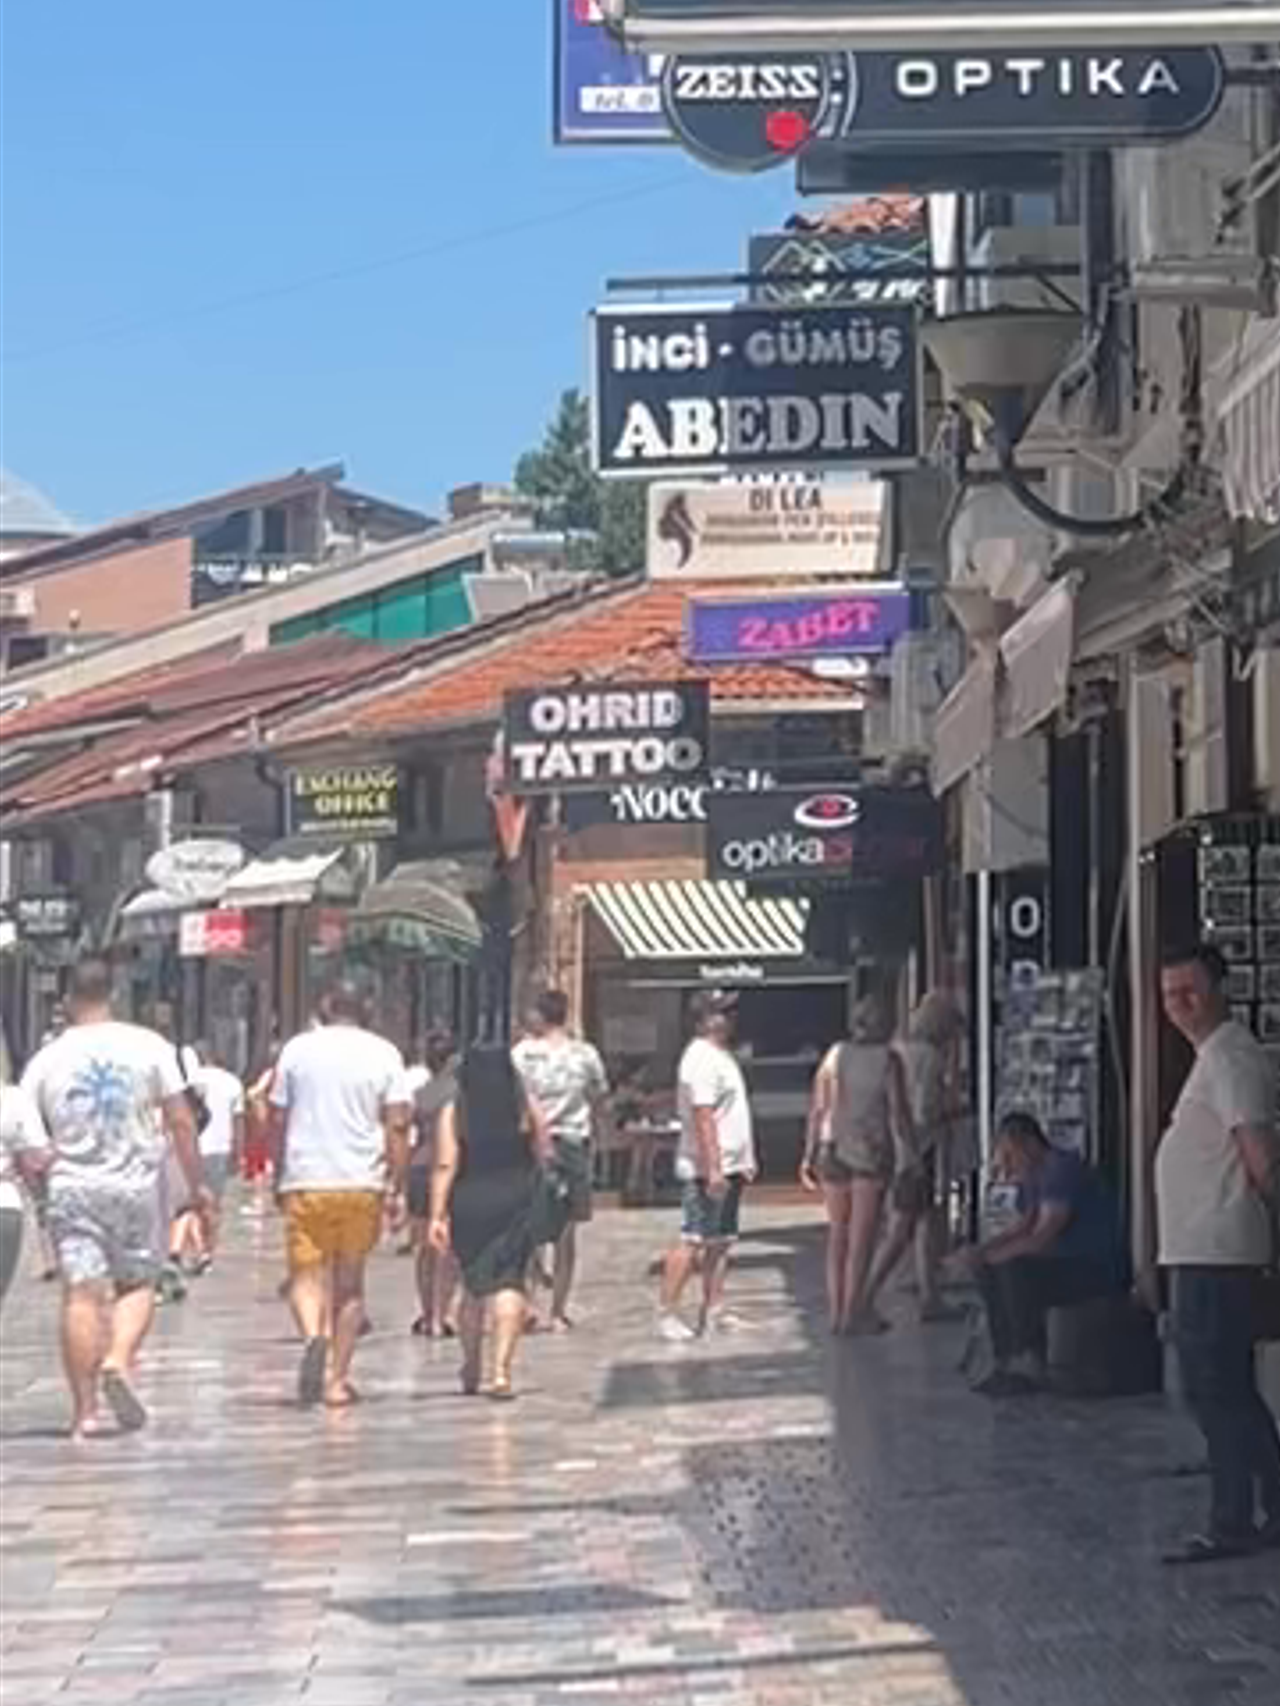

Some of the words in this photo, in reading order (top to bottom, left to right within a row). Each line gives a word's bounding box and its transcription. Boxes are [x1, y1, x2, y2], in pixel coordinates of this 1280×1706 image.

[675, 64, 821, 101] ZEISS
[895, 59, 1182, 98] OPTIKA
[744, 319, 902, 370] GÜMÜŞ
[613, 392, 903, 458] ABEDIN
[529, 690, 684, 732] OHRID
[511, 737, 702, 780] TATTOO
